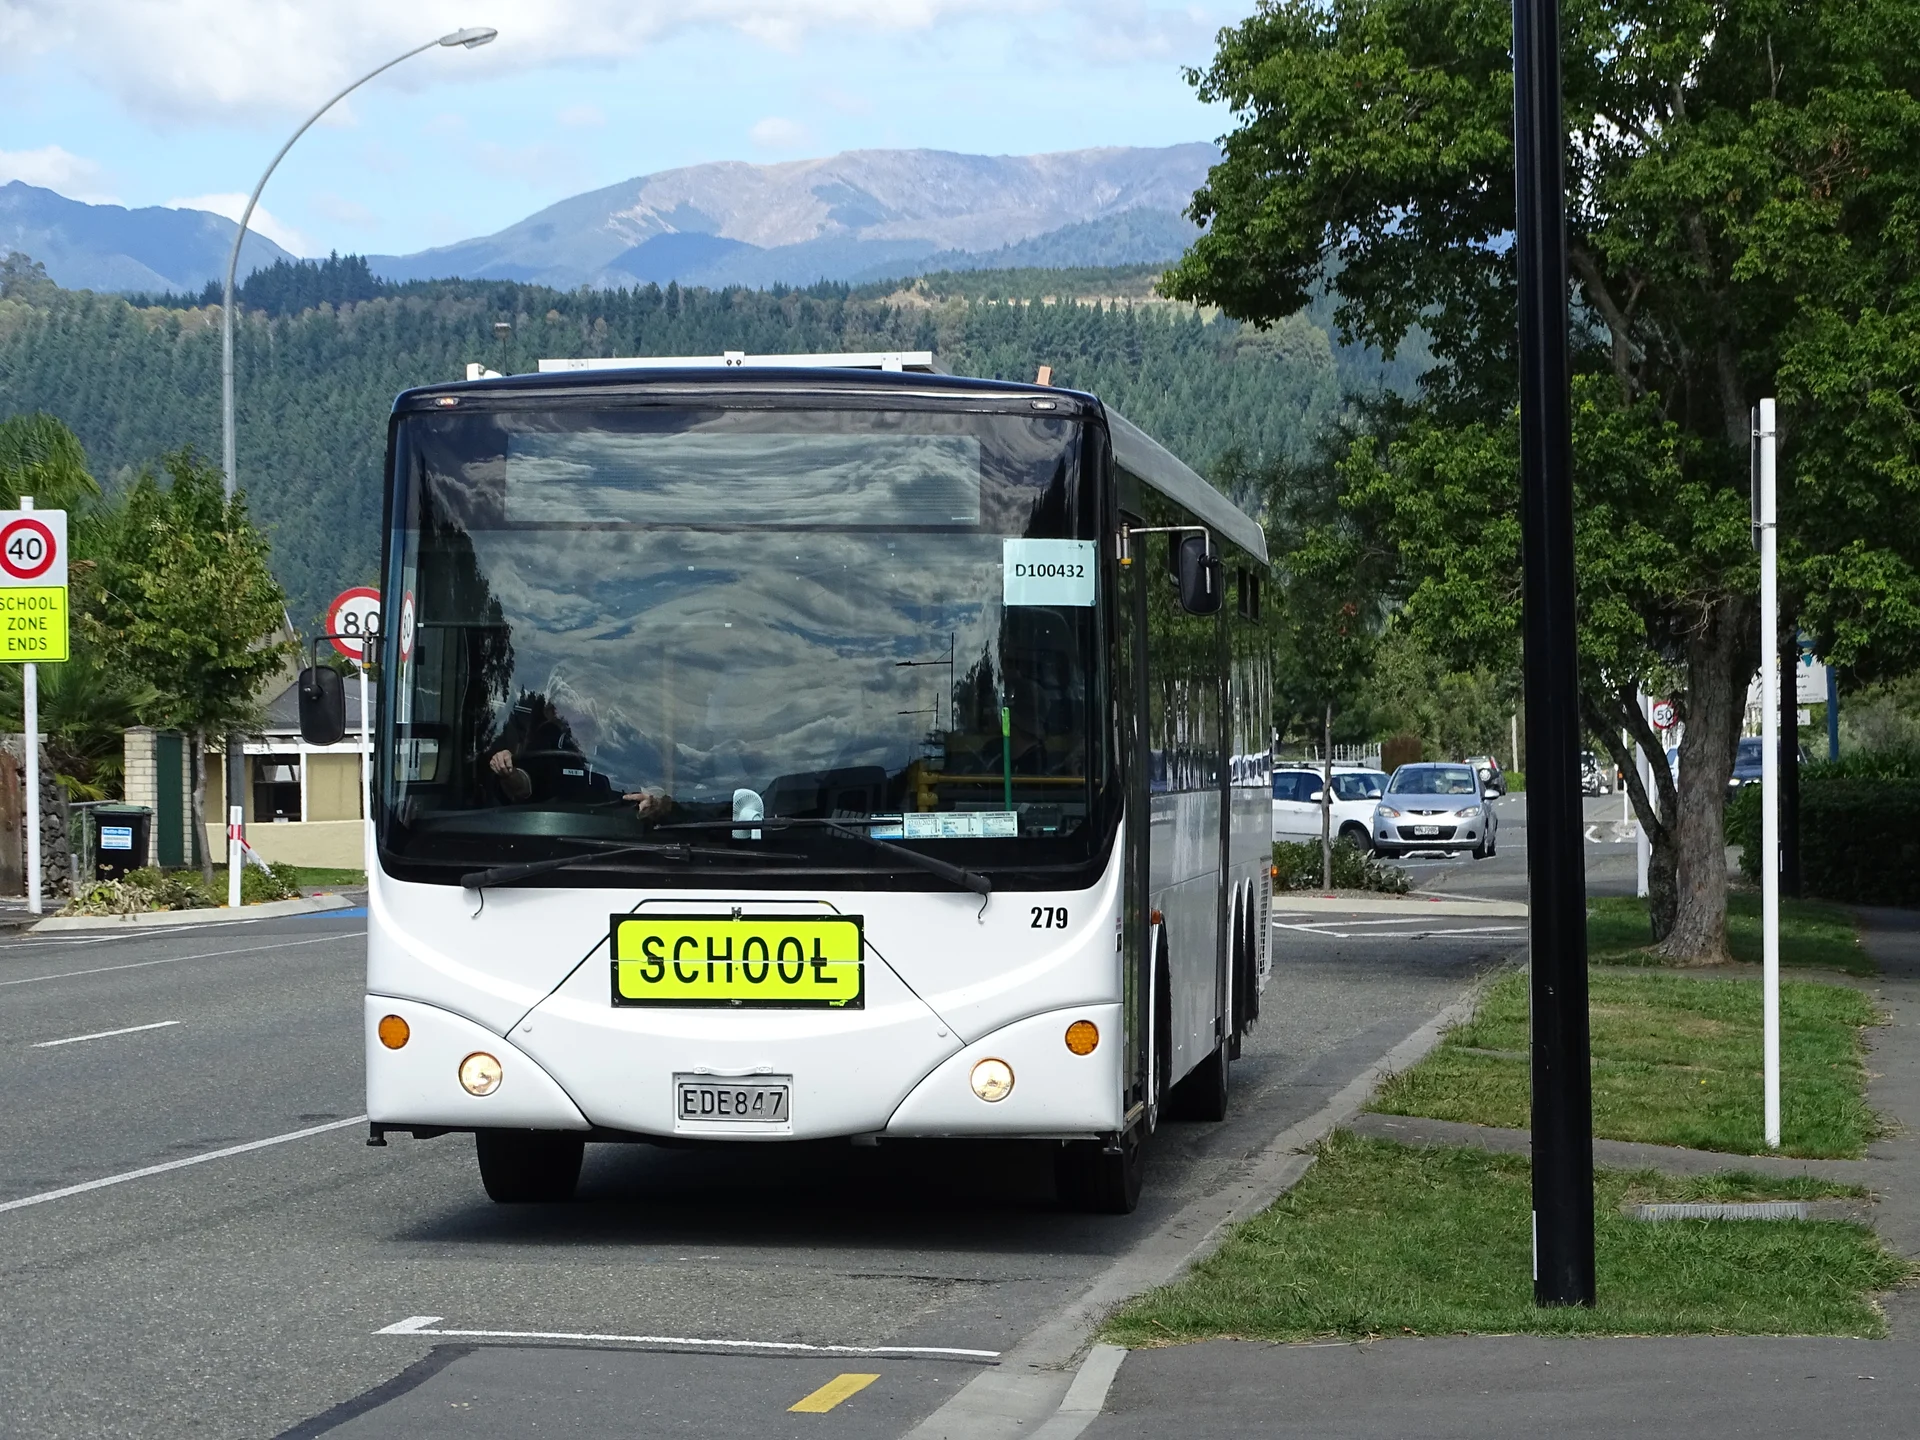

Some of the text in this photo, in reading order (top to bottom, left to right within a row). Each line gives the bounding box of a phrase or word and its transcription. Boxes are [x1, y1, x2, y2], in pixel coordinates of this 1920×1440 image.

[8, 537, 43, 560] 40
[1015, 563, 1084, 578] D100432
[0, 596, 58, 611] SCHOOL
[7, 616, 48, 631] ZONE
[343, 611, 380, 636] 80
[8, 637, 48, 651] ENDS
[1657, 710, 1673, 721] 50
[1030, 906, 1068, 929] 279
[640, 936, 838, 984] SCHOOL
[683, 1089, 783, 1115] EDE847
